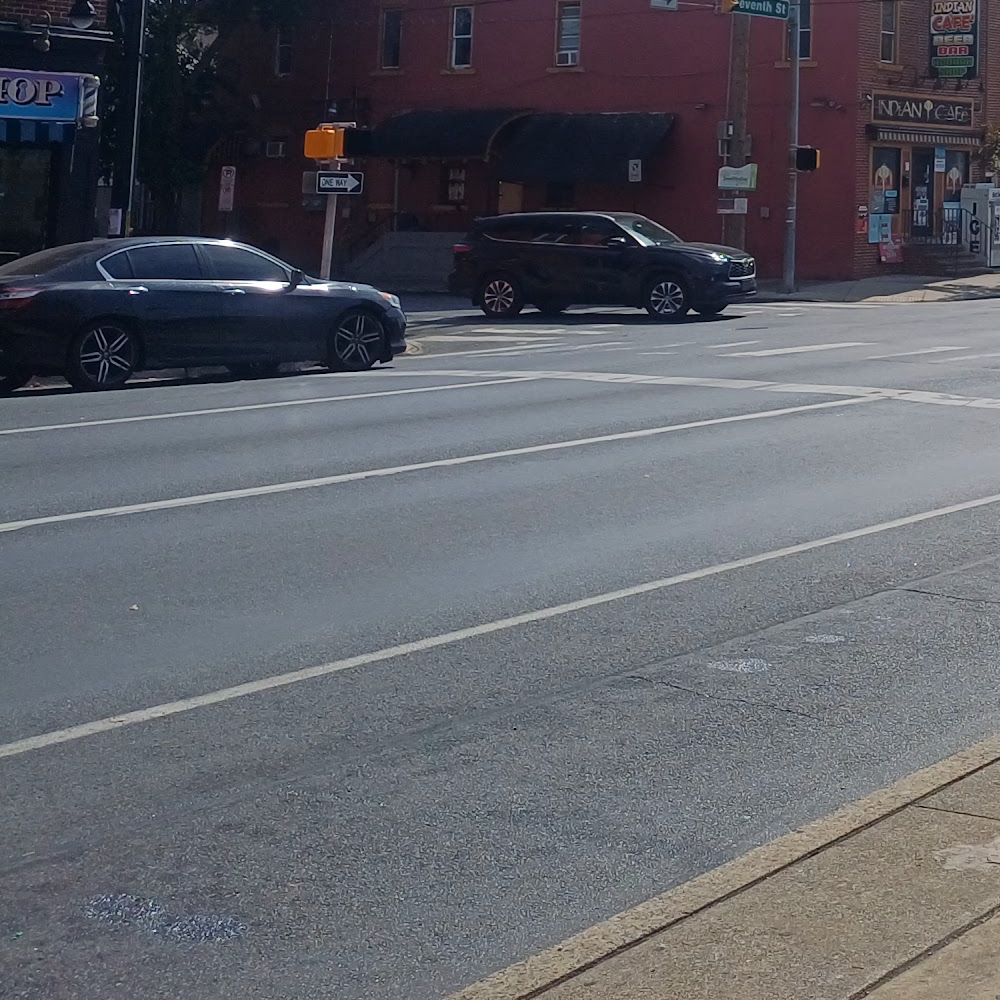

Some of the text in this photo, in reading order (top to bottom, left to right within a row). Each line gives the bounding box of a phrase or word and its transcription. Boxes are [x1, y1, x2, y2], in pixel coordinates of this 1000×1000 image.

[775, 2, 786, 15] St
[934, 1, 973, 13] INDIAN
[933, 34, 973, 46] BEER
[938, 47, 968, 55] BAR
[322, 178, 347, 187] ONE WAY
[969, 202, 980, 254] ICE
